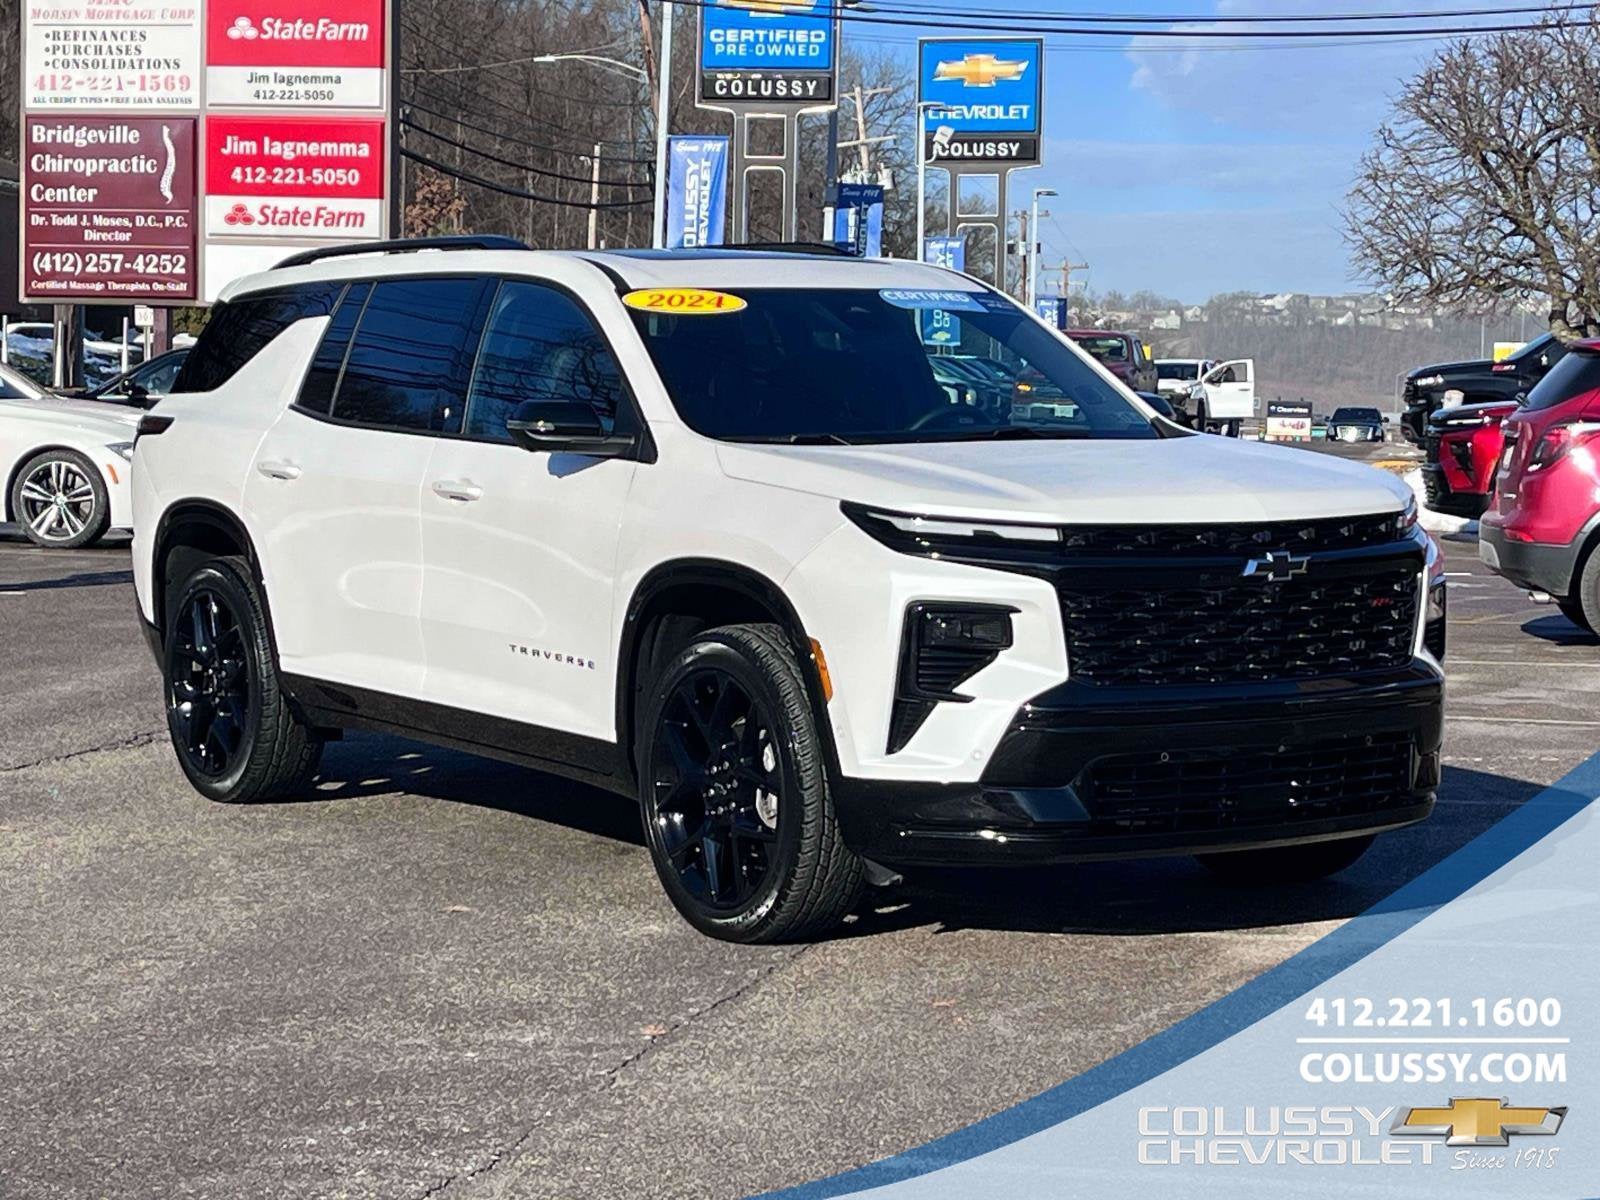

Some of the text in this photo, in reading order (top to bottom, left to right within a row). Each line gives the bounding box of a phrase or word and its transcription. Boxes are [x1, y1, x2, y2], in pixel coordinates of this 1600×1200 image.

[85, 8, 155, 20] MORTGAGE
[52, 30, 147, 42] REFINANCES
[709, 29, 826, 43] CERTIFIED
[52, 44, 142, 56] PURCHASES
[715, 44, 820, 56] PRE-OWNED
[52, 58, 181, 70] CONSOLIDATIONS
[34, 74, 191, 92] 412-221-1569
[247, 72, 269, 84] Jim
[715, 79, 817, 96] COLUSSY
[32, 96, 46, 104] ALL
[253, 90, 335, 101] 412-221-5050
[928, 104, 1030, 120] CHEVROLET
[32, 124, 140, 147] Bridgeville
[221, 135, 370, 160] Jim Iagnemma
[938, 142, 1020, 157] COLUSSY
[31, 153, 158, 176] Chiropractic
[230, 166, 360, 185] 412-221-5050
[31, 183, 98, 202] Center
[683, 158, 700, 247] OLUSSY
[698, 159, 712, 246] EVROLET
[31, 214, 49, 226] Dr.
[50, 214, 77, 226] Todd
[80, 215, 91, 227] J.
[92, 215, 133, 228] Moses,
[164, 216, 188, 228] P.C.
[84, 229, 133, 241] Director
[858, 201, 869, 257] VROLET
[33, 252, 186, 276] (412) 257-4252
[31, 280, 67, 290] Certified
[69, 280, 105, 292] Massage
[107, 281, 150, 292] Therapists
[648, 293, 724, 309] 2024
[883, 290, 971, 303] CERTIFIED
[509, 644, 595, 670] TRAVERSE
